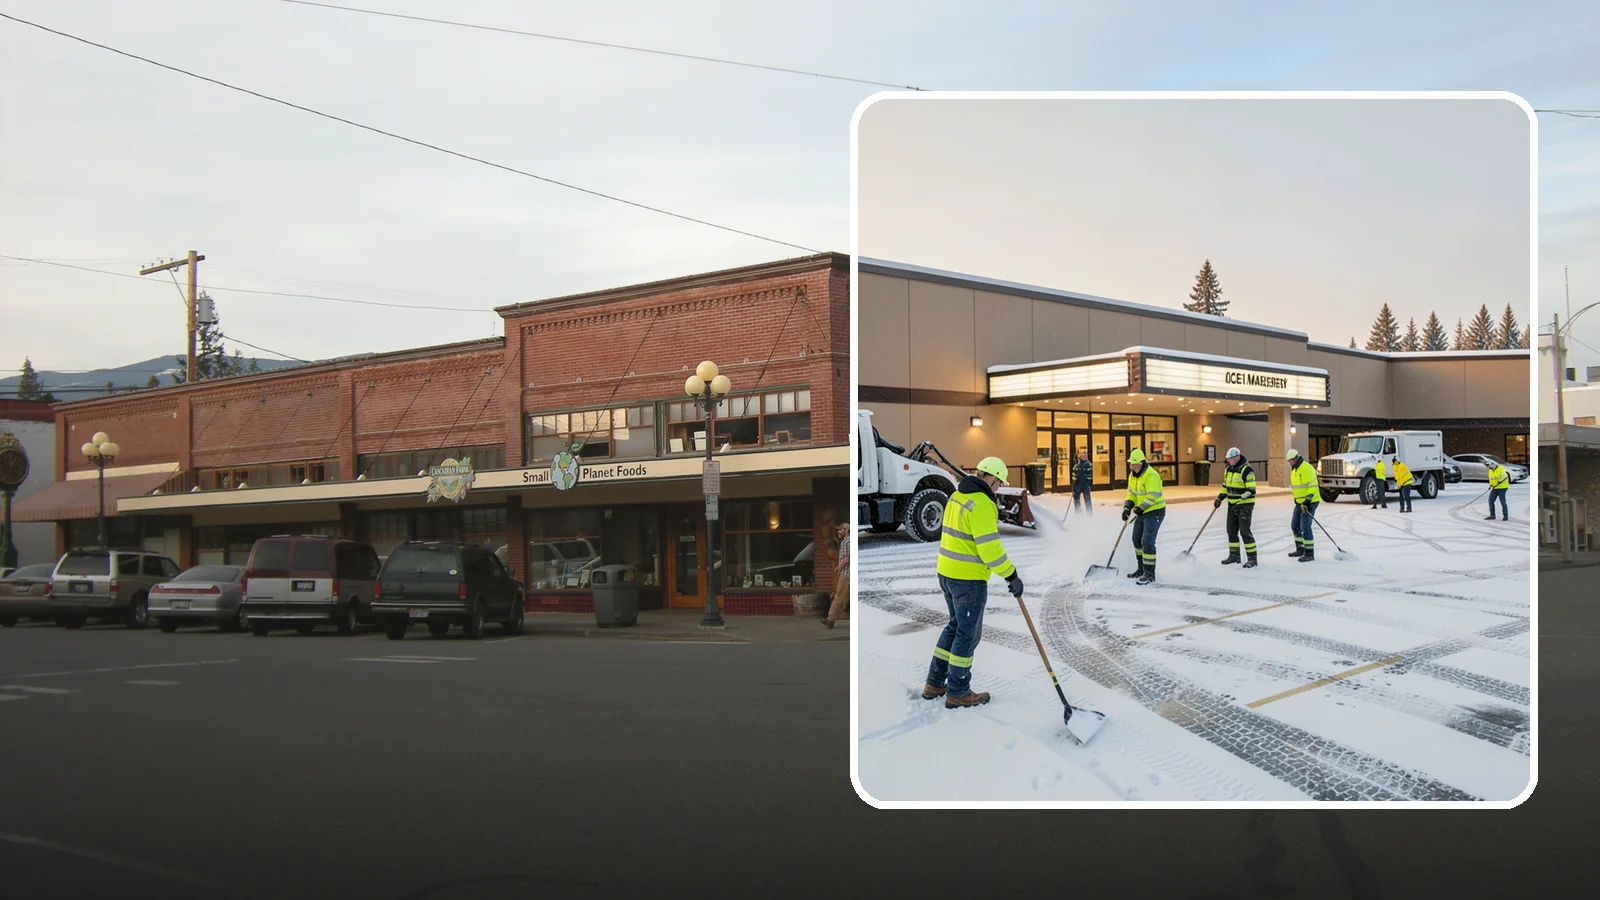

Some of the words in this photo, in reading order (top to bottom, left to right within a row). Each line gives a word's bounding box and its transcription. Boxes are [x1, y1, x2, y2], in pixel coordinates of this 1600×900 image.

[522, 471, 549, 483] Small
[582, 468, 614, 479] Planet
[617, 464, 647, 476] Foods
